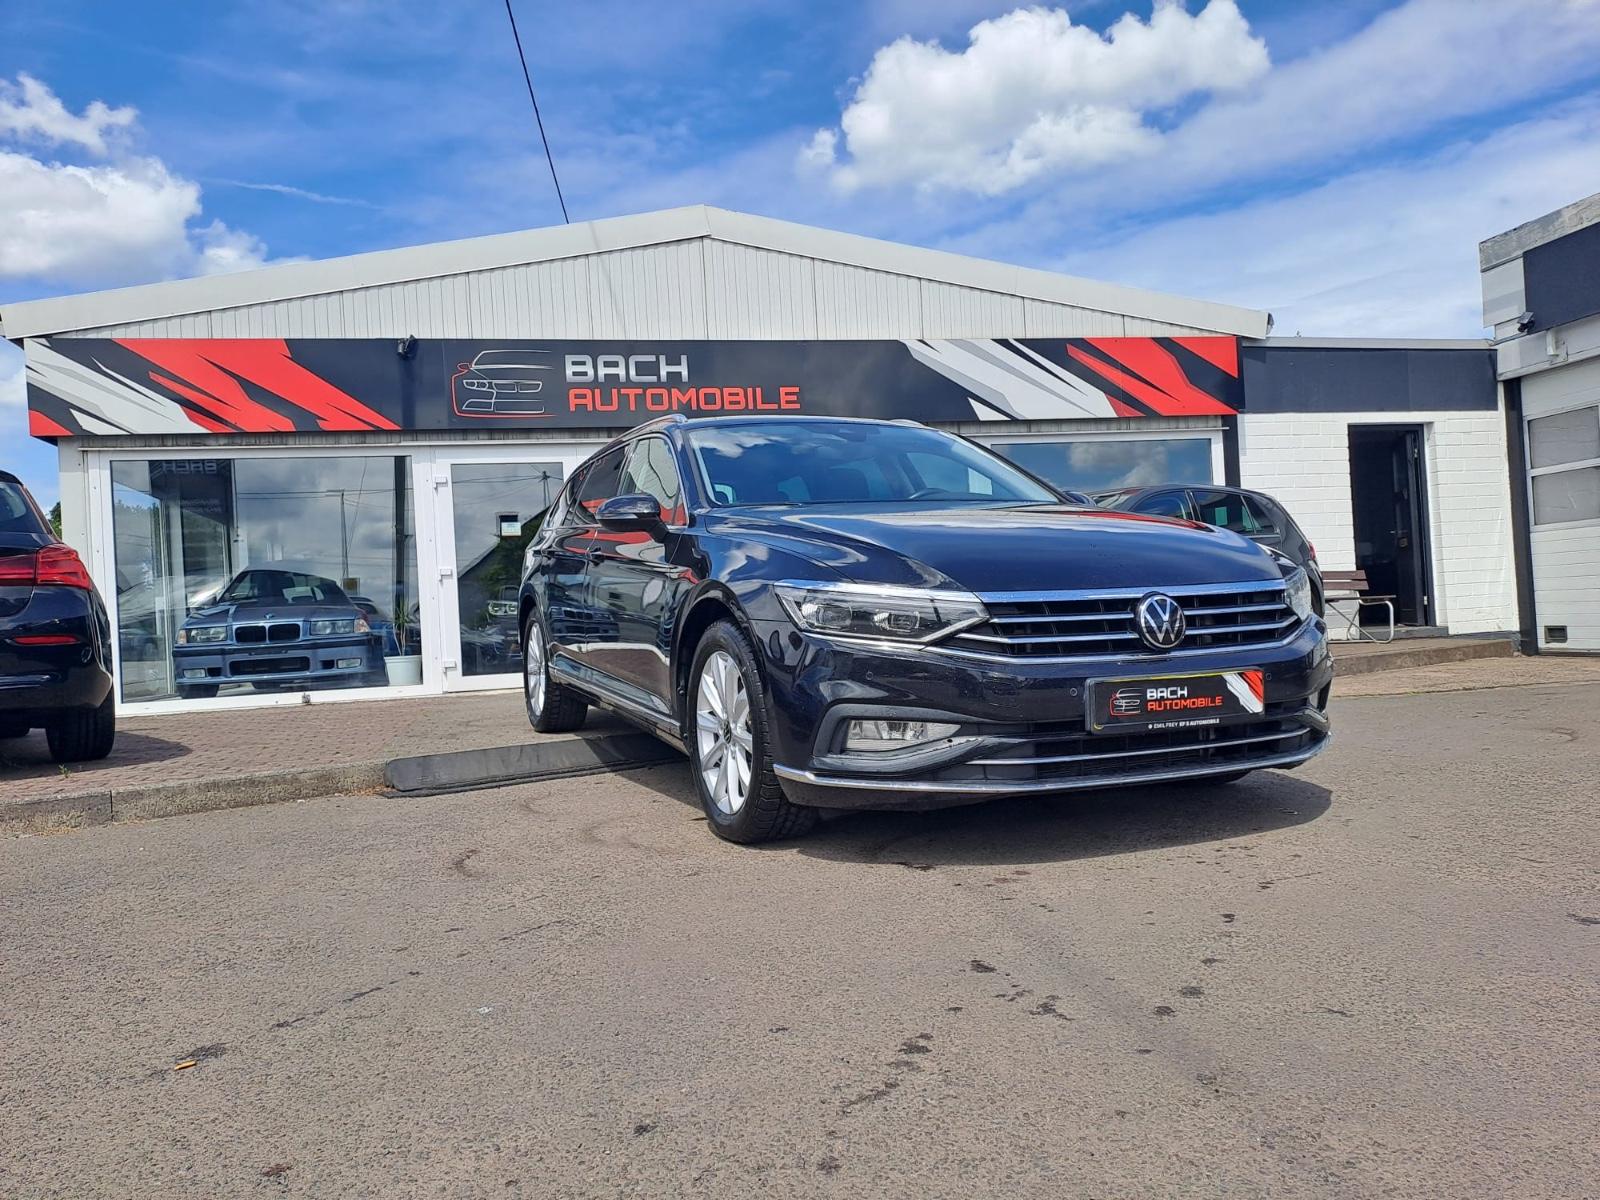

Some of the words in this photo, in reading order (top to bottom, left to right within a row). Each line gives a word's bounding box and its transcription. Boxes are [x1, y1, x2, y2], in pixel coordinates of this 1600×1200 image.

[565, 354, 689, 383] BACH
[568, 386, 801, 412] AUTOMOBILE
[1146, 686, 1188, 700] BACH
[1147, 696, 1223, 711] AUTOMOBILE
